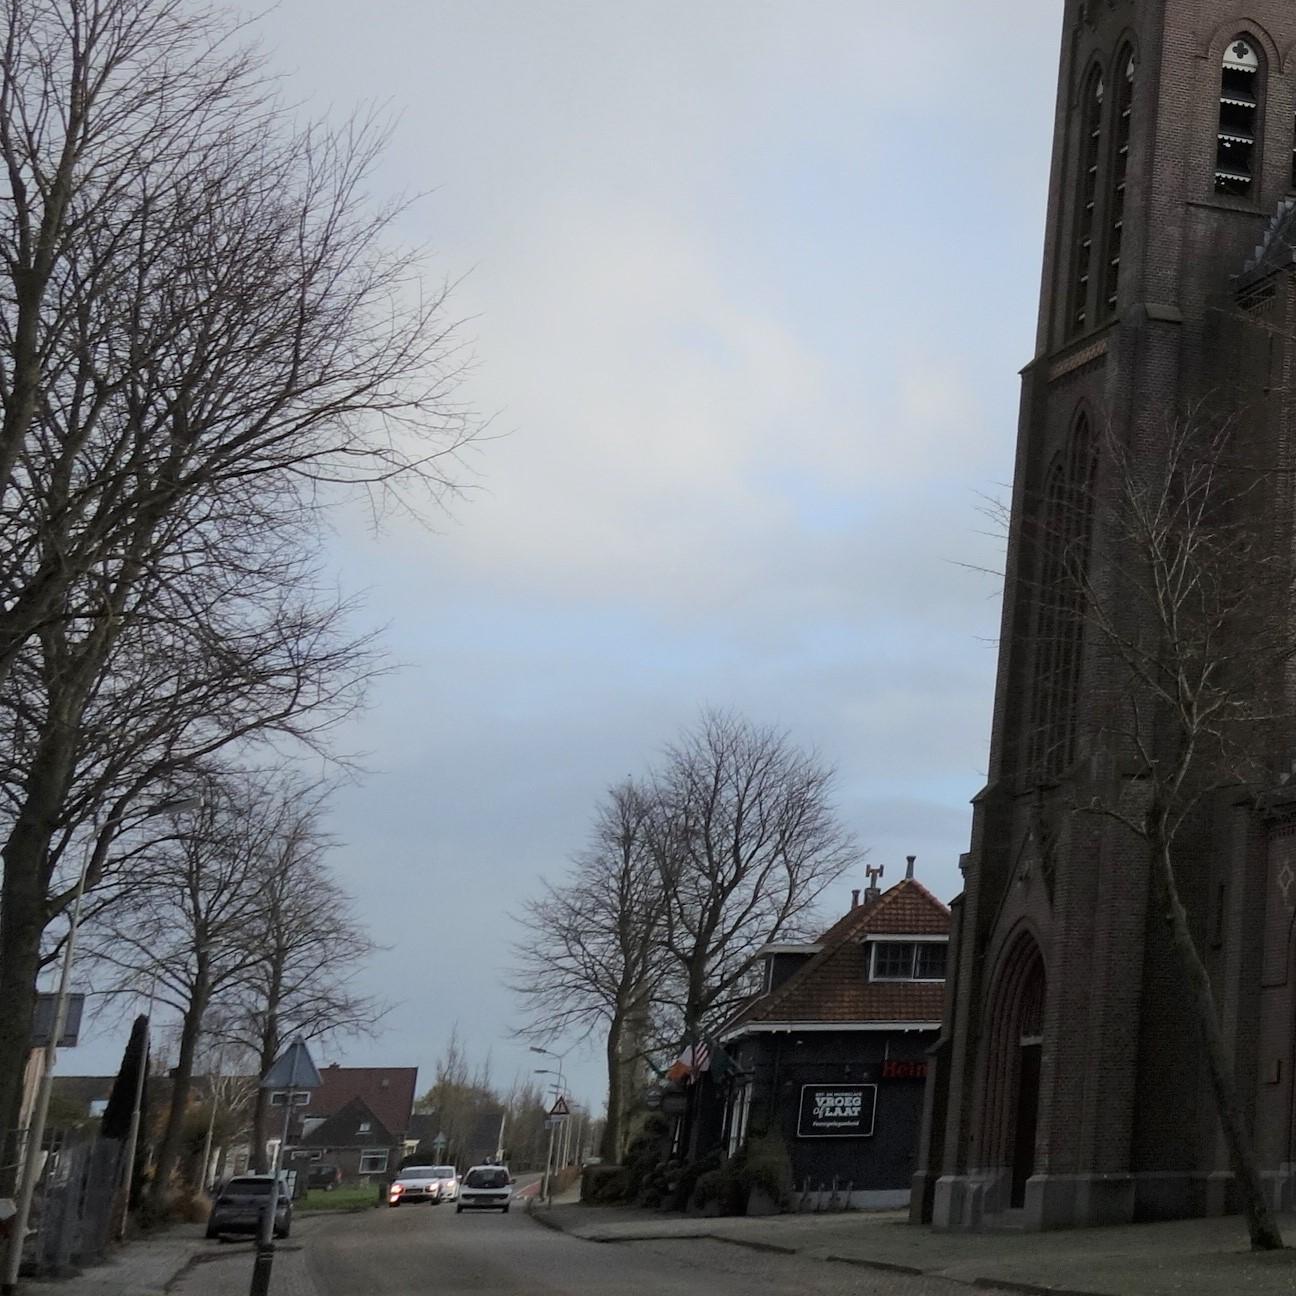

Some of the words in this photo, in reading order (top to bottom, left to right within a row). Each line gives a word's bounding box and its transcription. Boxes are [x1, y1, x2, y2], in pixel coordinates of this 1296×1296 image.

[815, 1097, 862, 1107] VROEG
[812, 1105, 825, 1119] of
[824, 1106, 861, 1117] LAAT
